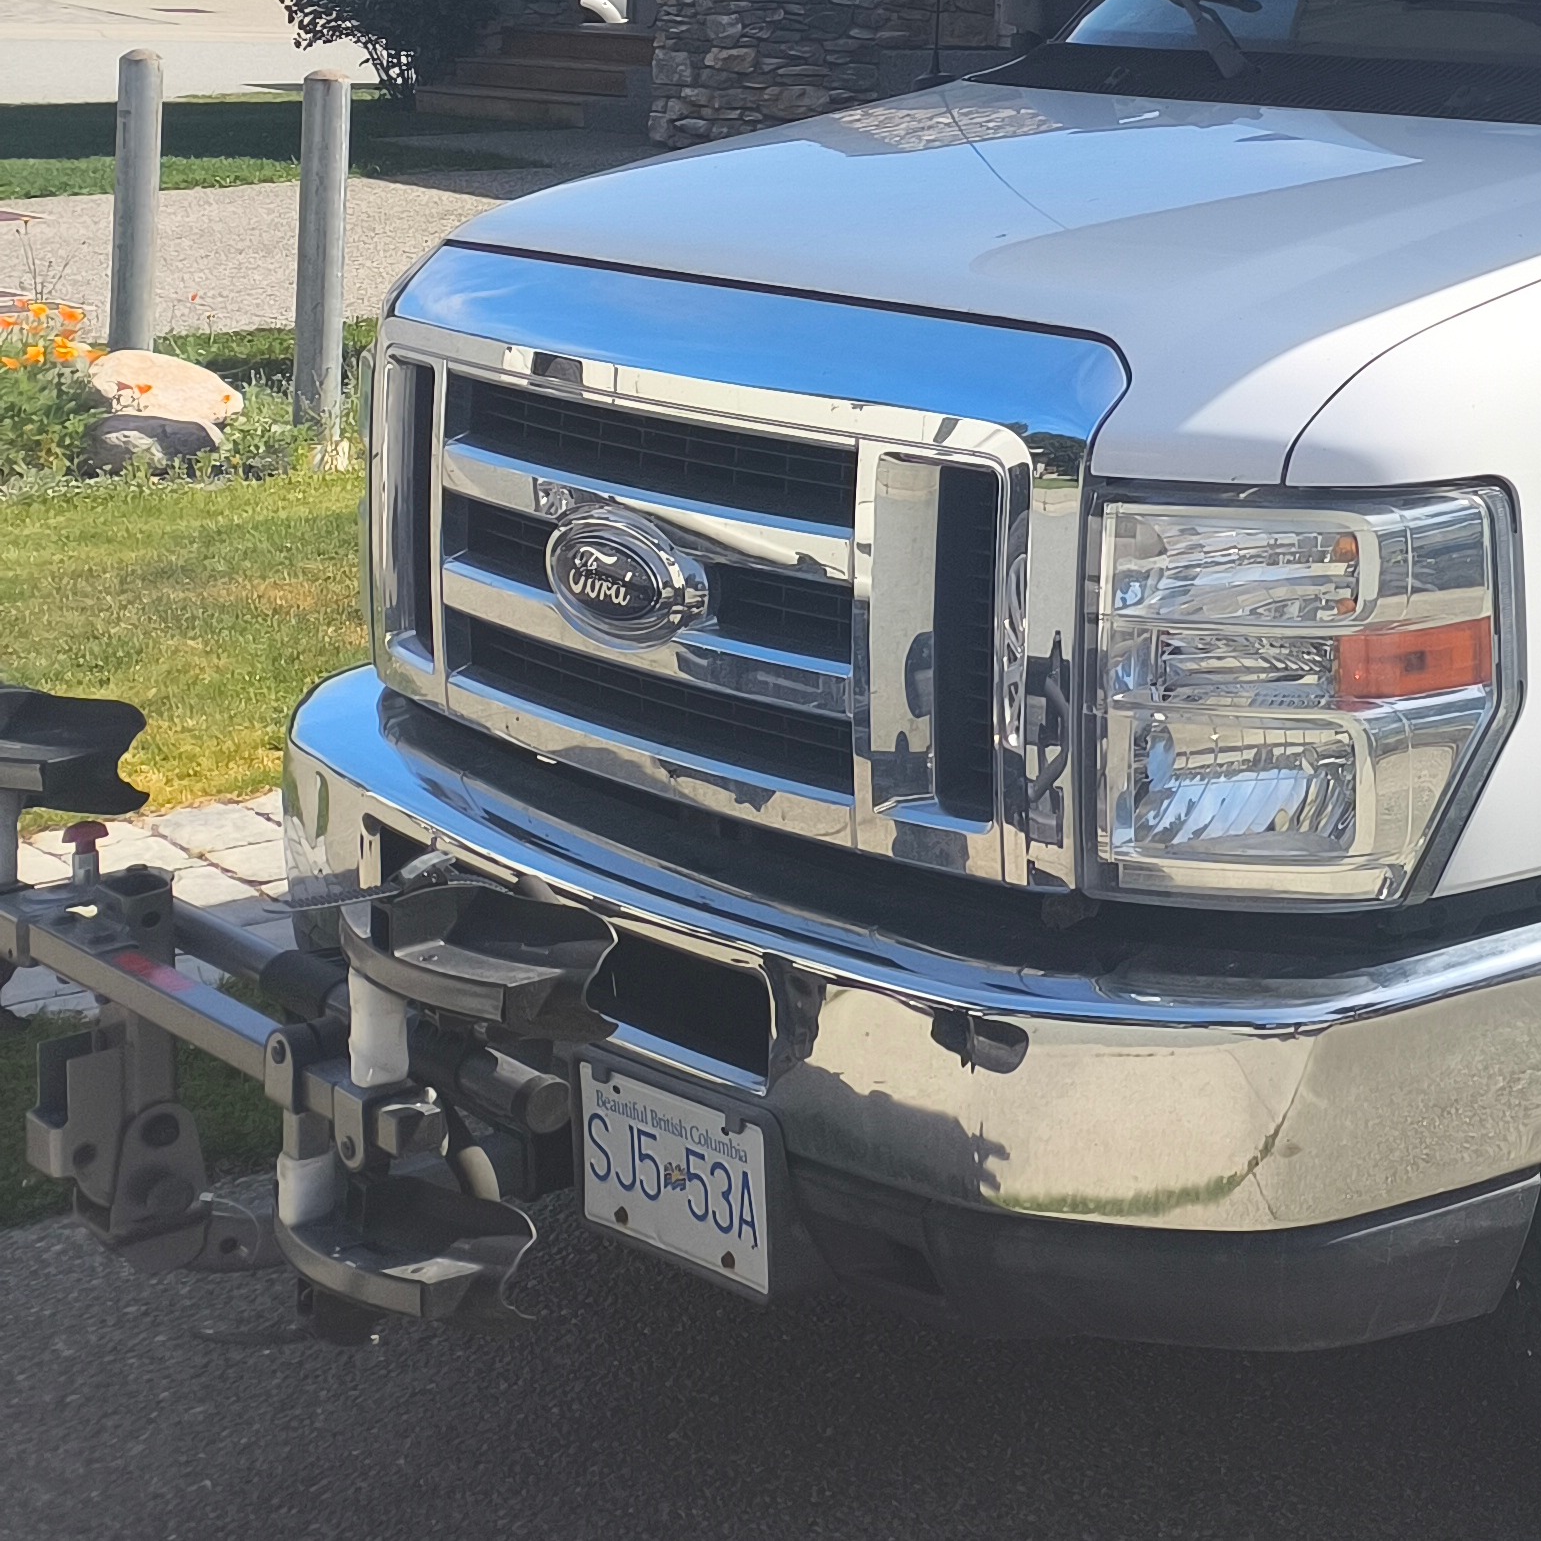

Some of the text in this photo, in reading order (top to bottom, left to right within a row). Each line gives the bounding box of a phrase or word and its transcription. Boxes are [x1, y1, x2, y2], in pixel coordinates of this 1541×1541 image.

[569, 546, 631, 607] Ford
[595, 1089, 748, 1164] Beautiful British Columbia
[587, 1113, 759, 1249] SJ5 53A
